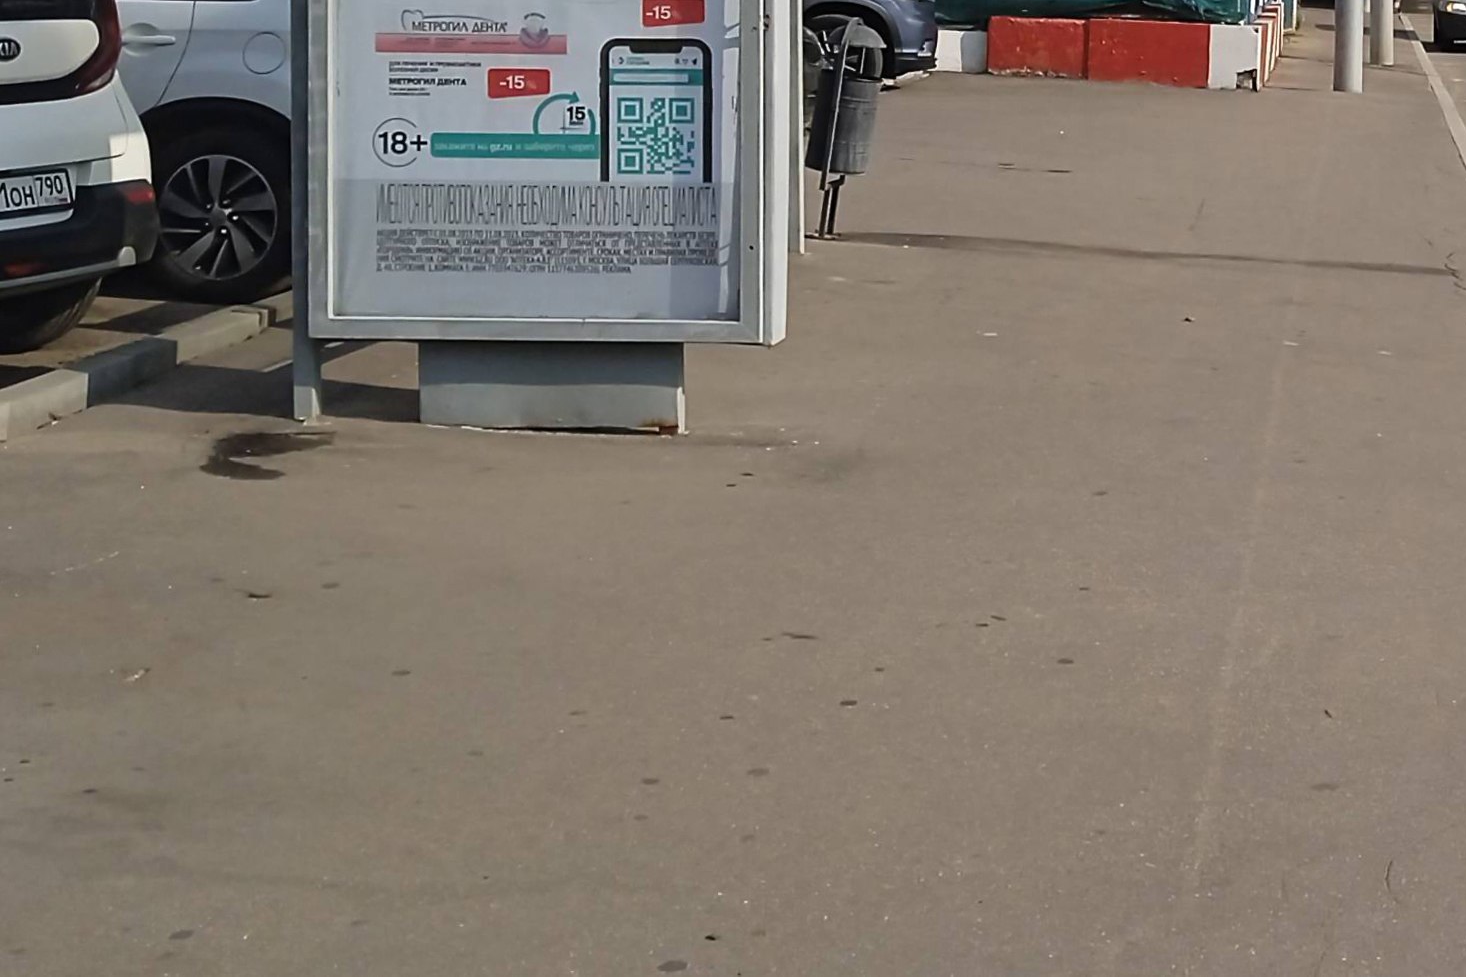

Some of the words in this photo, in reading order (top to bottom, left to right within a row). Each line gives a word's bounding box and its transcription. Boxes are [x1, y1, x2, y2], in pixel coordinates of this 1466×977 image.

[412, 21, 469, 32] МЕТРОГИЛ
[437, 78, 467, 86] ДЕНТА
[566, 106, 586, 121] 15
[378, 132, 428, 155] 18+
[35, 174, 65, 197] 790
